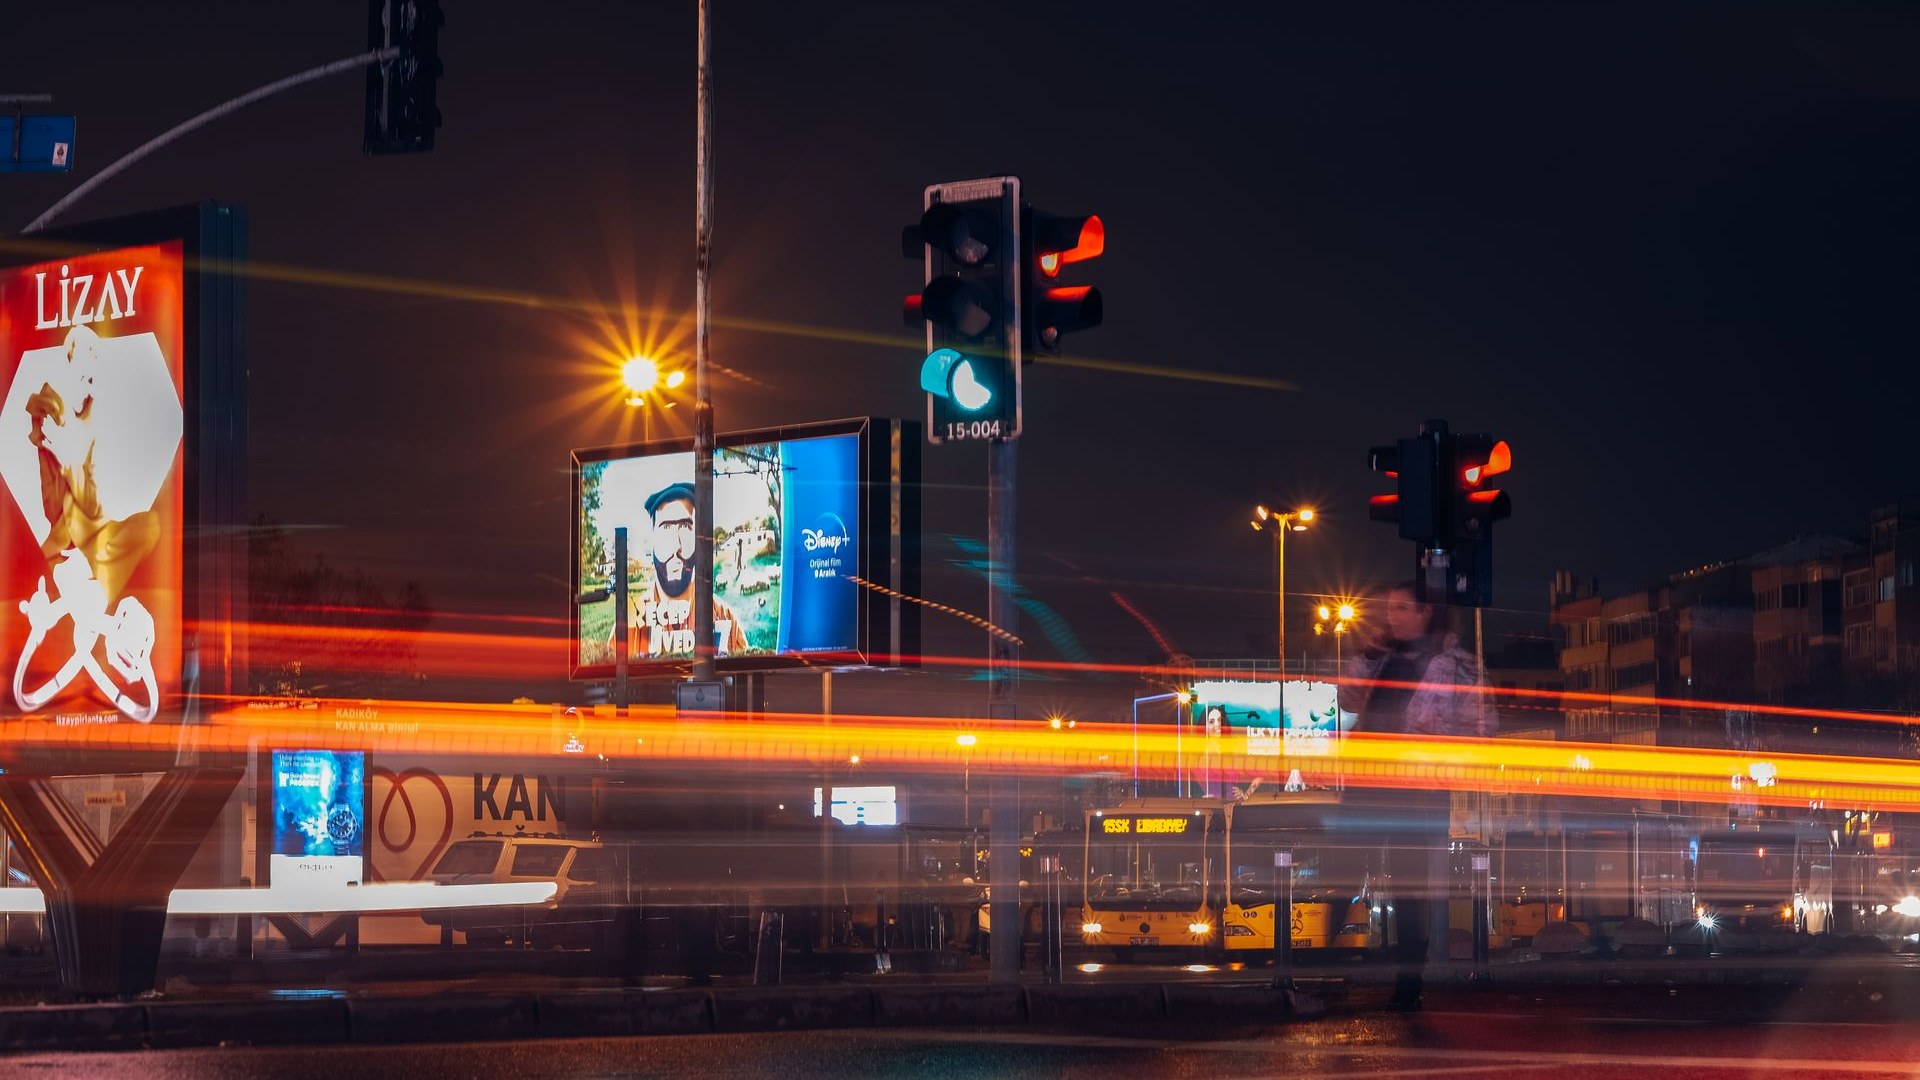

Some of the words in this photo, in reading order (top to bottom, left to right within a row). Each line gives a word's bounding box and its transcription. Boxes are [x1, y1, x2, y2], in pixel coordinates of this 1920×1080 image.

[947, 420, 1000, 440] 15-004
[802, 528, 850, 554] Disney+
[56, 714, 118, 727] lizaypirlanta.com
[336, 707, 378, 719] KADIKÖY
[335, 720, 356, 732] KAN
[358, 721, 385, 733] ALMA
[473, 773, 567, 821] KAN
